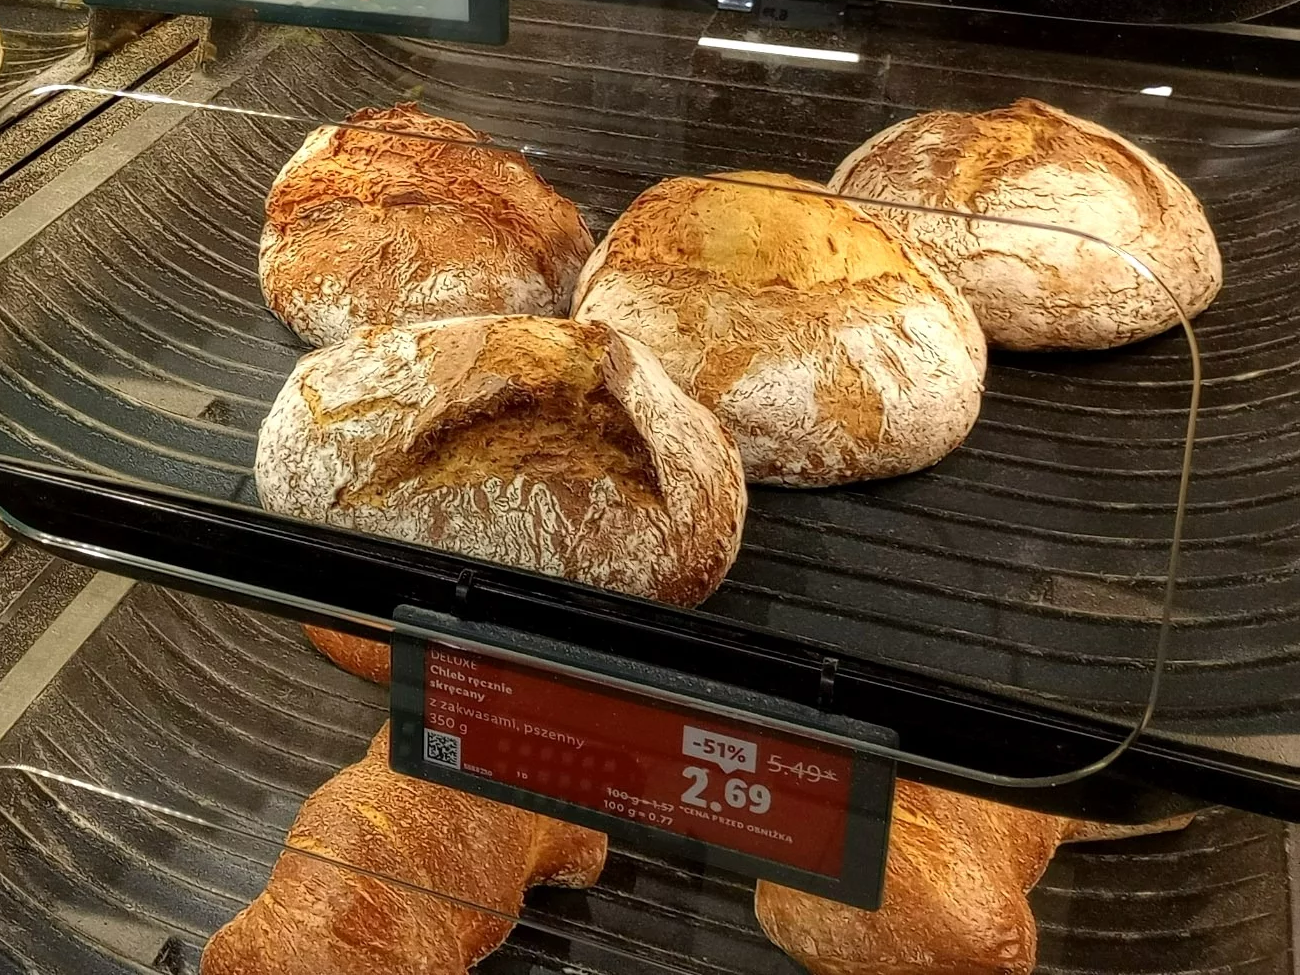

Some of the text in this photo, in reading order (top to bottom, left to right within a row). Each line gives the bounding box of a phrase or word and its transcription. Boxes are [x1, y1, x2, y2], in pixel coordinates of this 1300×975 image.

[431, 651, 478, 670] DELUXE
[429, 679, 486, 703] skręcany
[430, 665, 513, 695] Chleb ręcznie
[429, 697, 585, 750] z zakwasami, pszenny
[429, 712, 468, 735] 350 g
[693, 738, 746, 764] -51%
[606, 787, 629, 801] 100
[631, 795, 639, 806] g
[652, 800, 674, 812] 1.57
[680, 765, 771, 815] 2.69
[603, 799, 624, 813] 100
[628, 807, 636, 818] g
[648, 812, 674, 826] 0.77
[711, 814, 744, 829] PRZED
